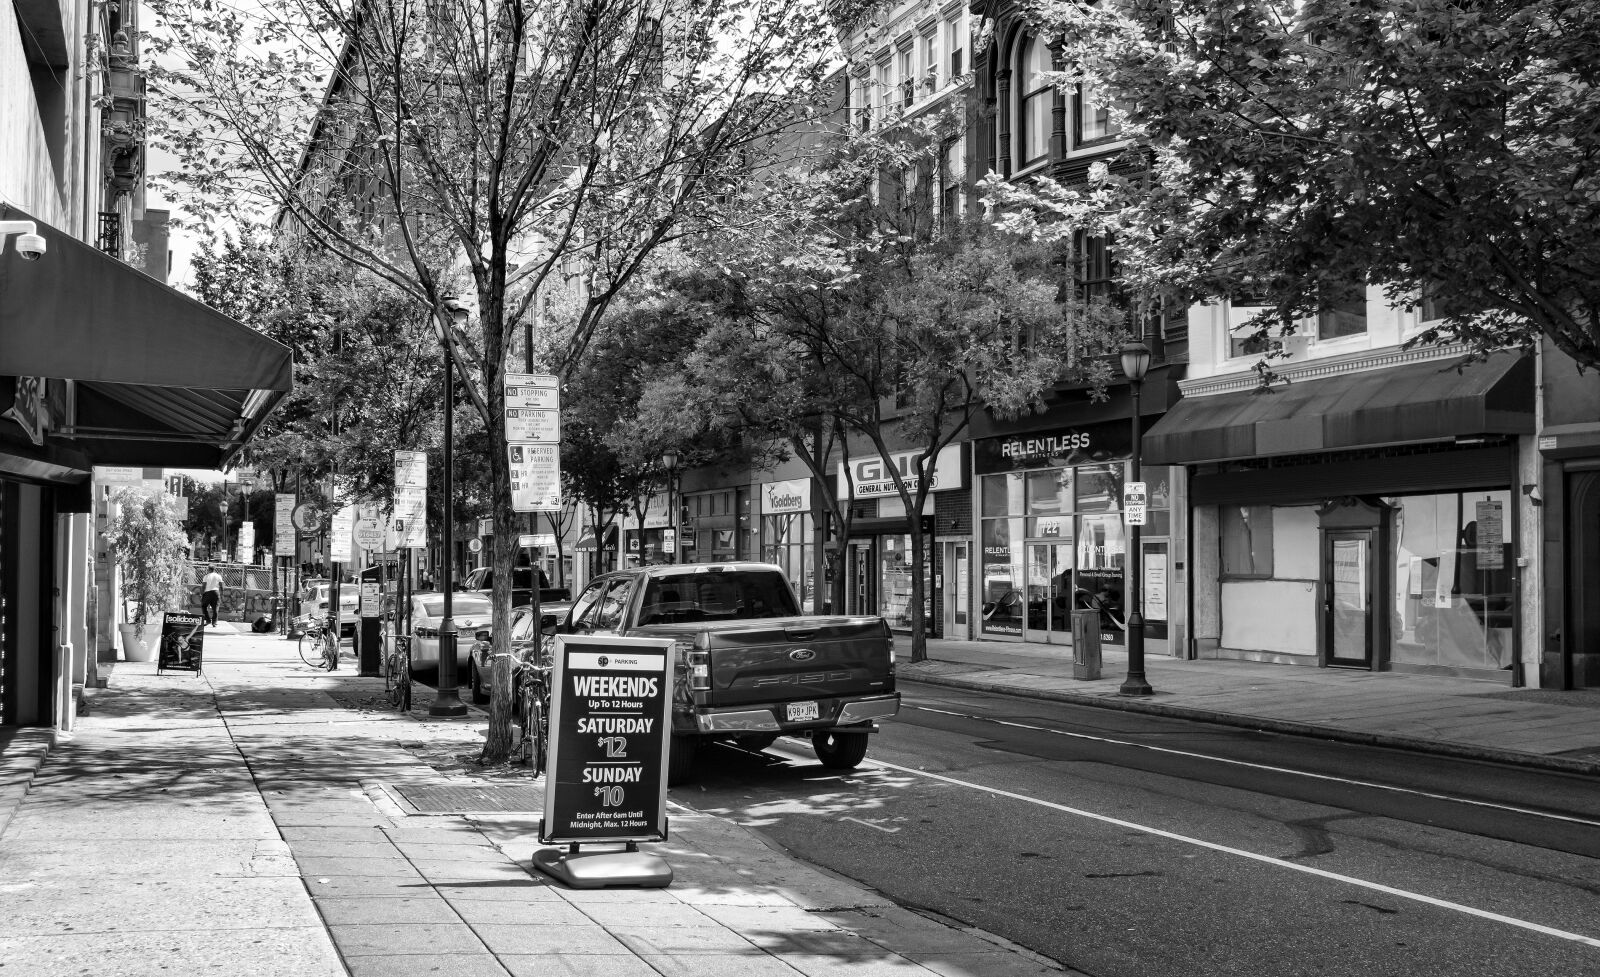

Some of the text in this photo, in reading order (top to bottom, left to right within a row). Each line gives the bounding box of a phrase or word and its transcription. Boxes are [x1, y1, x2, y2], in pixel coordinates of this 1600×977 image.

[520, 389, 548, 397] STOPPING
[1002, 432, 1090, 458] RELENTLESS
[858, 484, 882, 494] GENERAL
[884, 480, 912, 492] NUTRON
[573, 676, 658, 698] WEEKENDS
[588, 700, 643, 710] Up To 12 Hours
[805, 706, 817, 716] JPK
[578, 718, 654, 734] SATURDAY
[598, 736, 627, 758] $12
[582, 767, 643, 783] SUNDAY
[594, 786, 624, 806] $10
[570, 821, 602, 830] Midnight,
